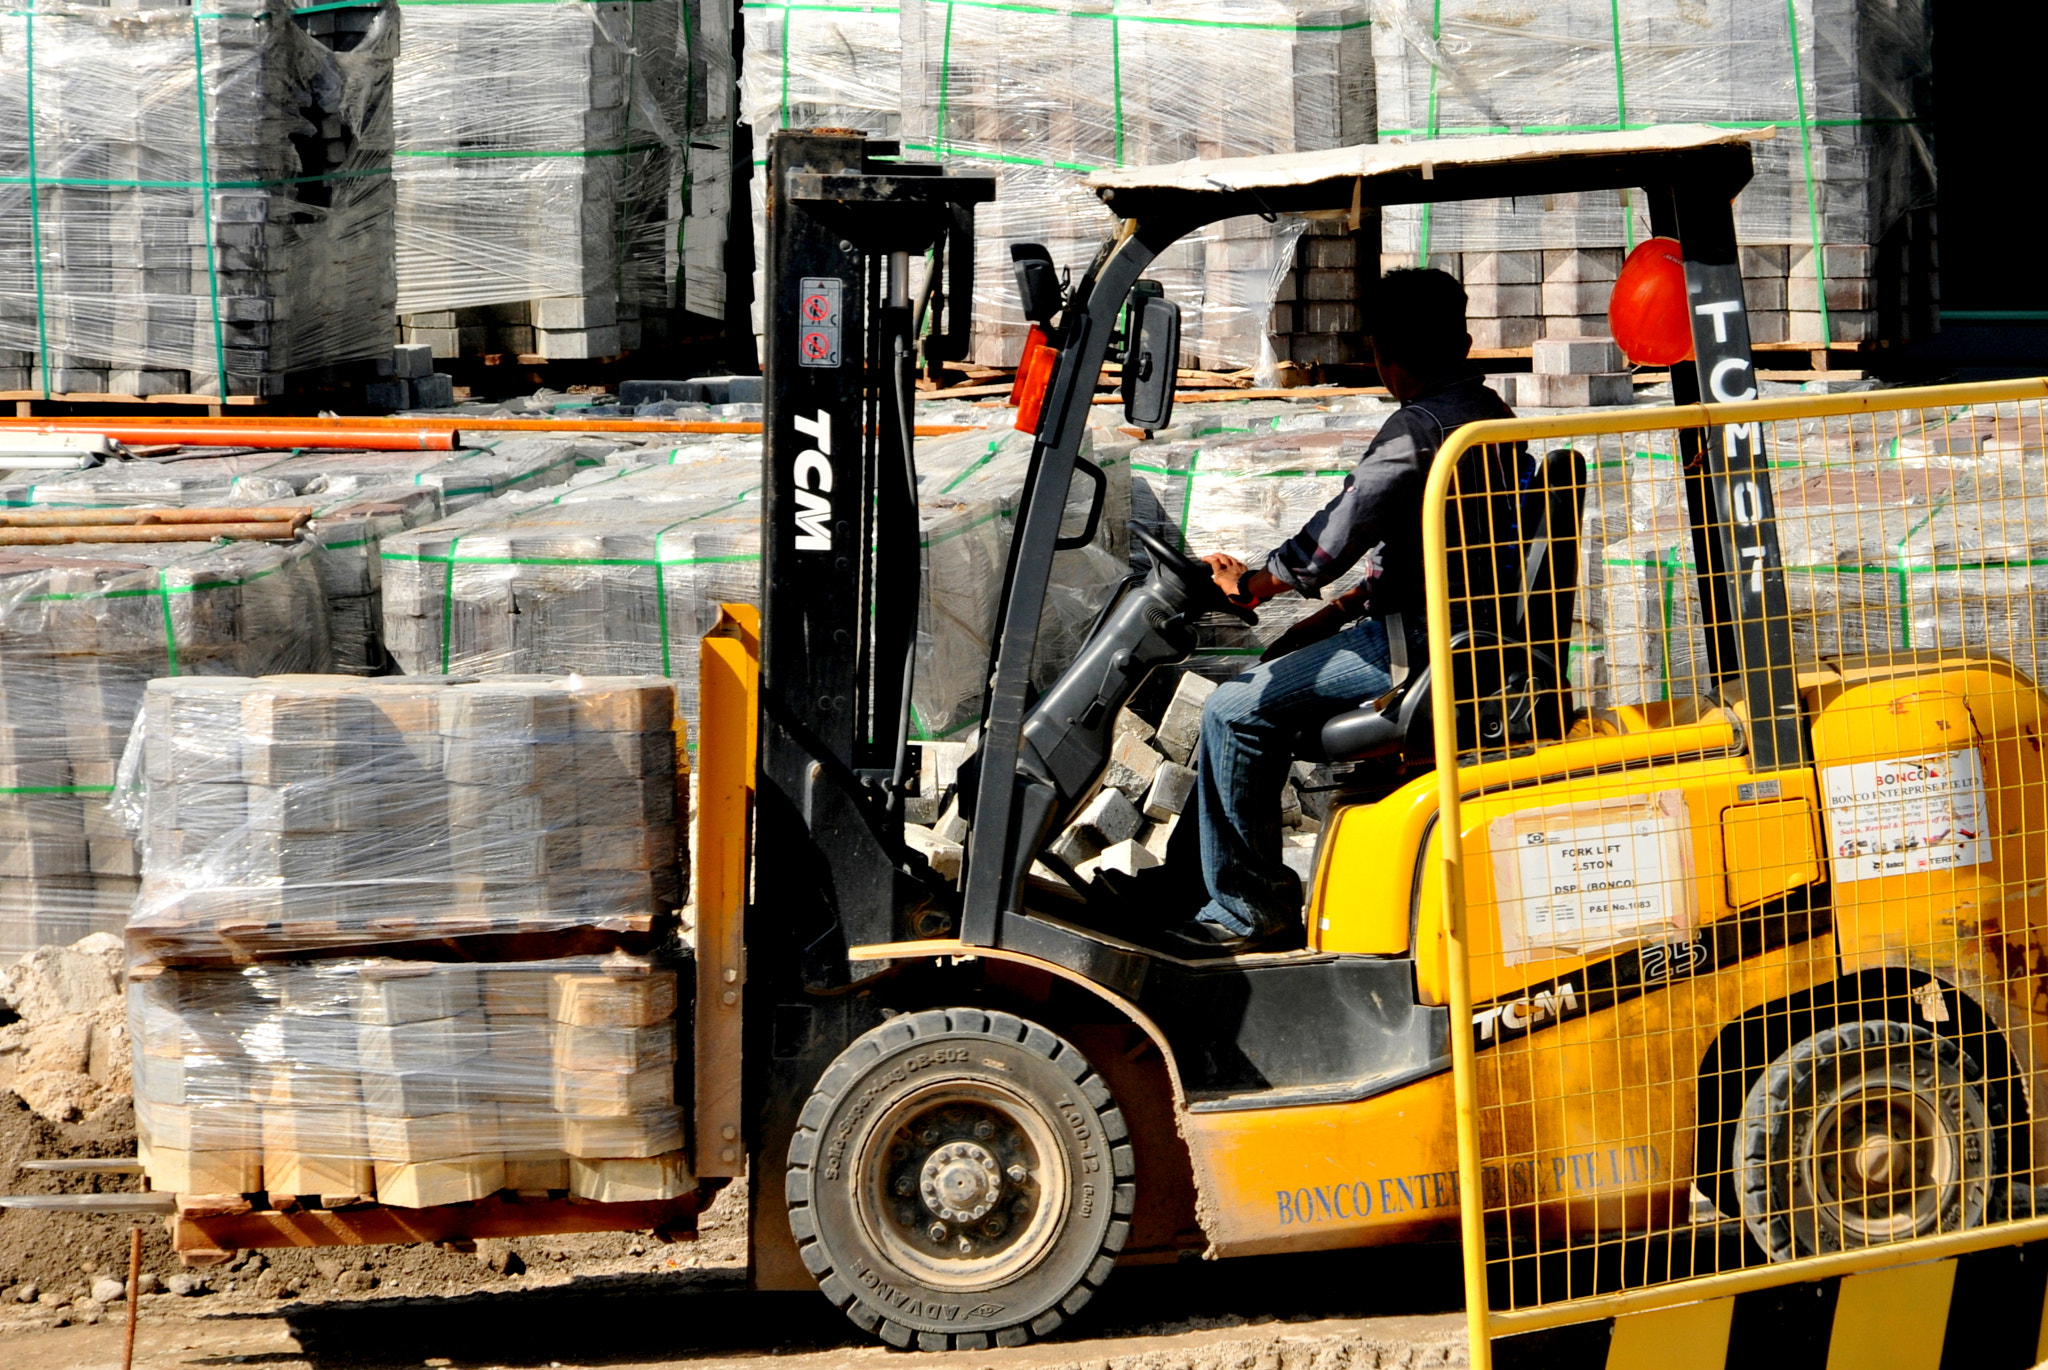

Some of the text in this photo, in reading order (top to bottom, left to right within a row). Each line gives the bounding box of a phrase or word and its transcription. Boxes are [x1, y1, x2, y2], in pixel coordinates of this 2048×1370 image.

[793, 408, 833, 551] TCM
[1832, 792, 1870, 805] BONCO
[1872, 783, 1938, 800] ENTERPRISE
[1876, 769, 1929, 786] BONCO
[1562, 844, 1622, 858] FORK LFT
[1587, 879, 1636, 893] (BONCO)
[1589, 902, 1610, 913] P&E
[1641, 932, 1708, 986] 25
[1471, 982, 1579, 1041] TCM
[1056, 1093, 1101, 1174] 7.00-12
[1275, 1181, 1372, 1226] BONCO
[1552, 1151, 1605, 1193] PTE
[1608, 1143, 1661, 1185] LTD
[849, 1257, 961, 1322] ADVANCE
